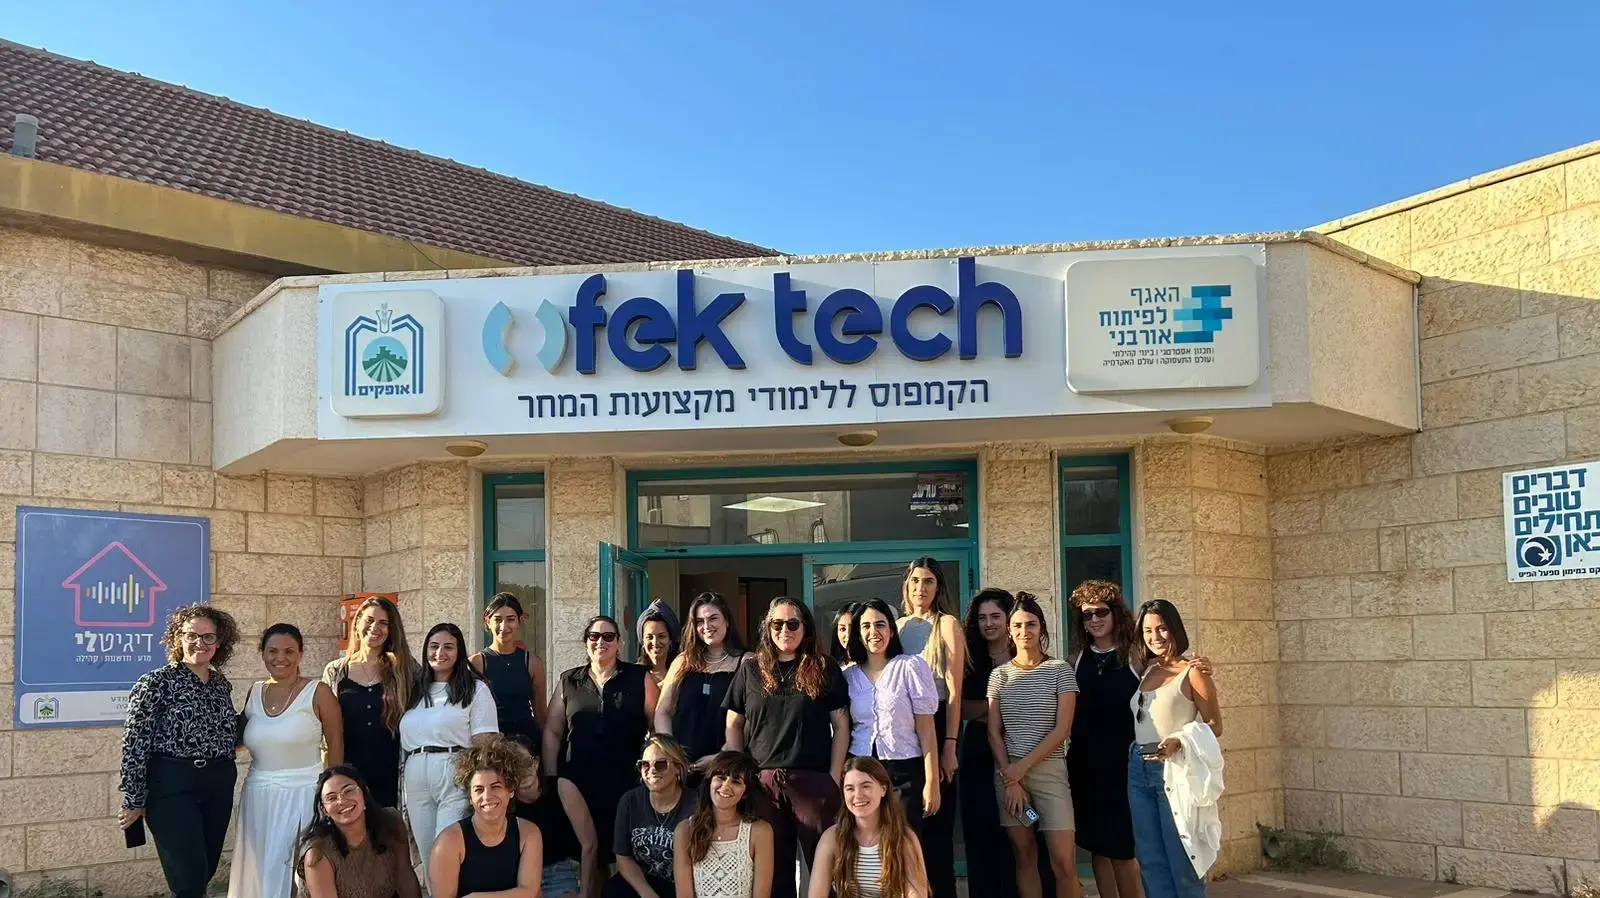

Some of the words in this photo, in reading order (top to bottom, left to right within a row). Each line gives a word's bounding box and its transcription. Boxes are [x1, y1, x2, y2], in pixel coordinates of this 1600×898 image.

[1130, 286, 1180, 306] האגף
[773, 257, 1023, 366] tech
[1099, 306, 1168, 327] לפיתוח
[1109, 328, 1173, 346] אורבני
[1102, 358, 1135, 367] האקדמיה
[1137, 358, 1154, 366] עולם
[1194, 356, 1212, 364] עולם
[358, 384, 411, 399] אופקים
[748, 379, 857, 411] ללימודי
[868, 377, 990, 411] הקמפוס
[517, 392, 599, 419] המחר
[608, 388, 736, 420] מקצועות
[1512, 468, 1588, 495] דברים
[1513, 490, 1582, 515] טובים
[1514, 510, 1600, 536] תחילים
[1538, 569, 1560, 577] מפעל
[1563, 568, 1587, 577] במימון
[75, 631, 154, 652] דיגיטלי
[76, 654, 99, 663] קהילה
